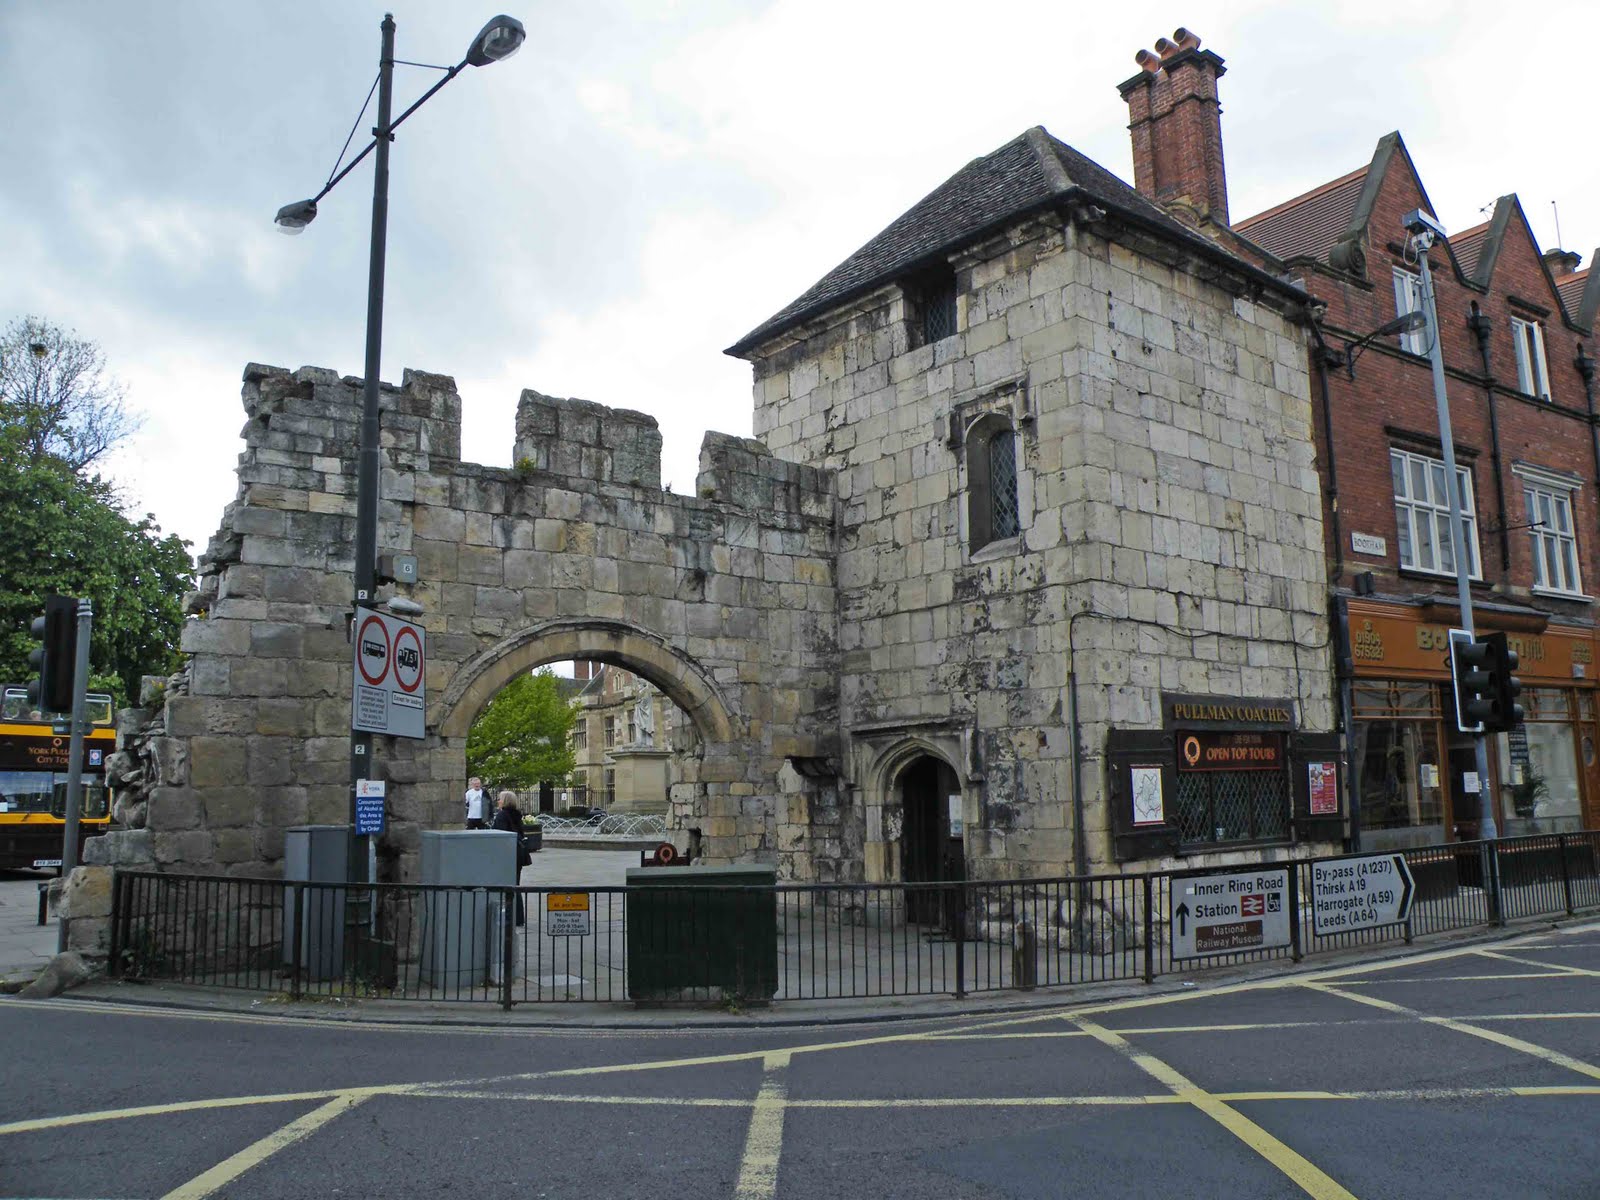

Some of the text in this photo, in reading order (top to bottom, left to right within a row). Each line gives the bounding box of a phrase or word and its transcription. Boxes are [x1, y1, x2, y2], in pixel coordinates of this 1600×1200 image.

[1354, 537, 1385, 551] BOOTHAM
[1174, 703, 1290, 722] PULLMAN COACHES
[1206, 747, 1275, 760] OPEN TOP TOURS
[1315, 860, 1392, 881] By-pass (A1237)
[1194, 876, 1283, 896] Inner Ring Road
[1316, 879, 1366, 896] Thirsk A19
[1195, 903, 1238, 918] Station
[1317, 895, 1364, 912] Harrogate
[1318, 909, 1378, 928] Leeds (A64)
[1213, 924, 1247, 936] National
[1197, 935, 1263, 949] Railway Museum
